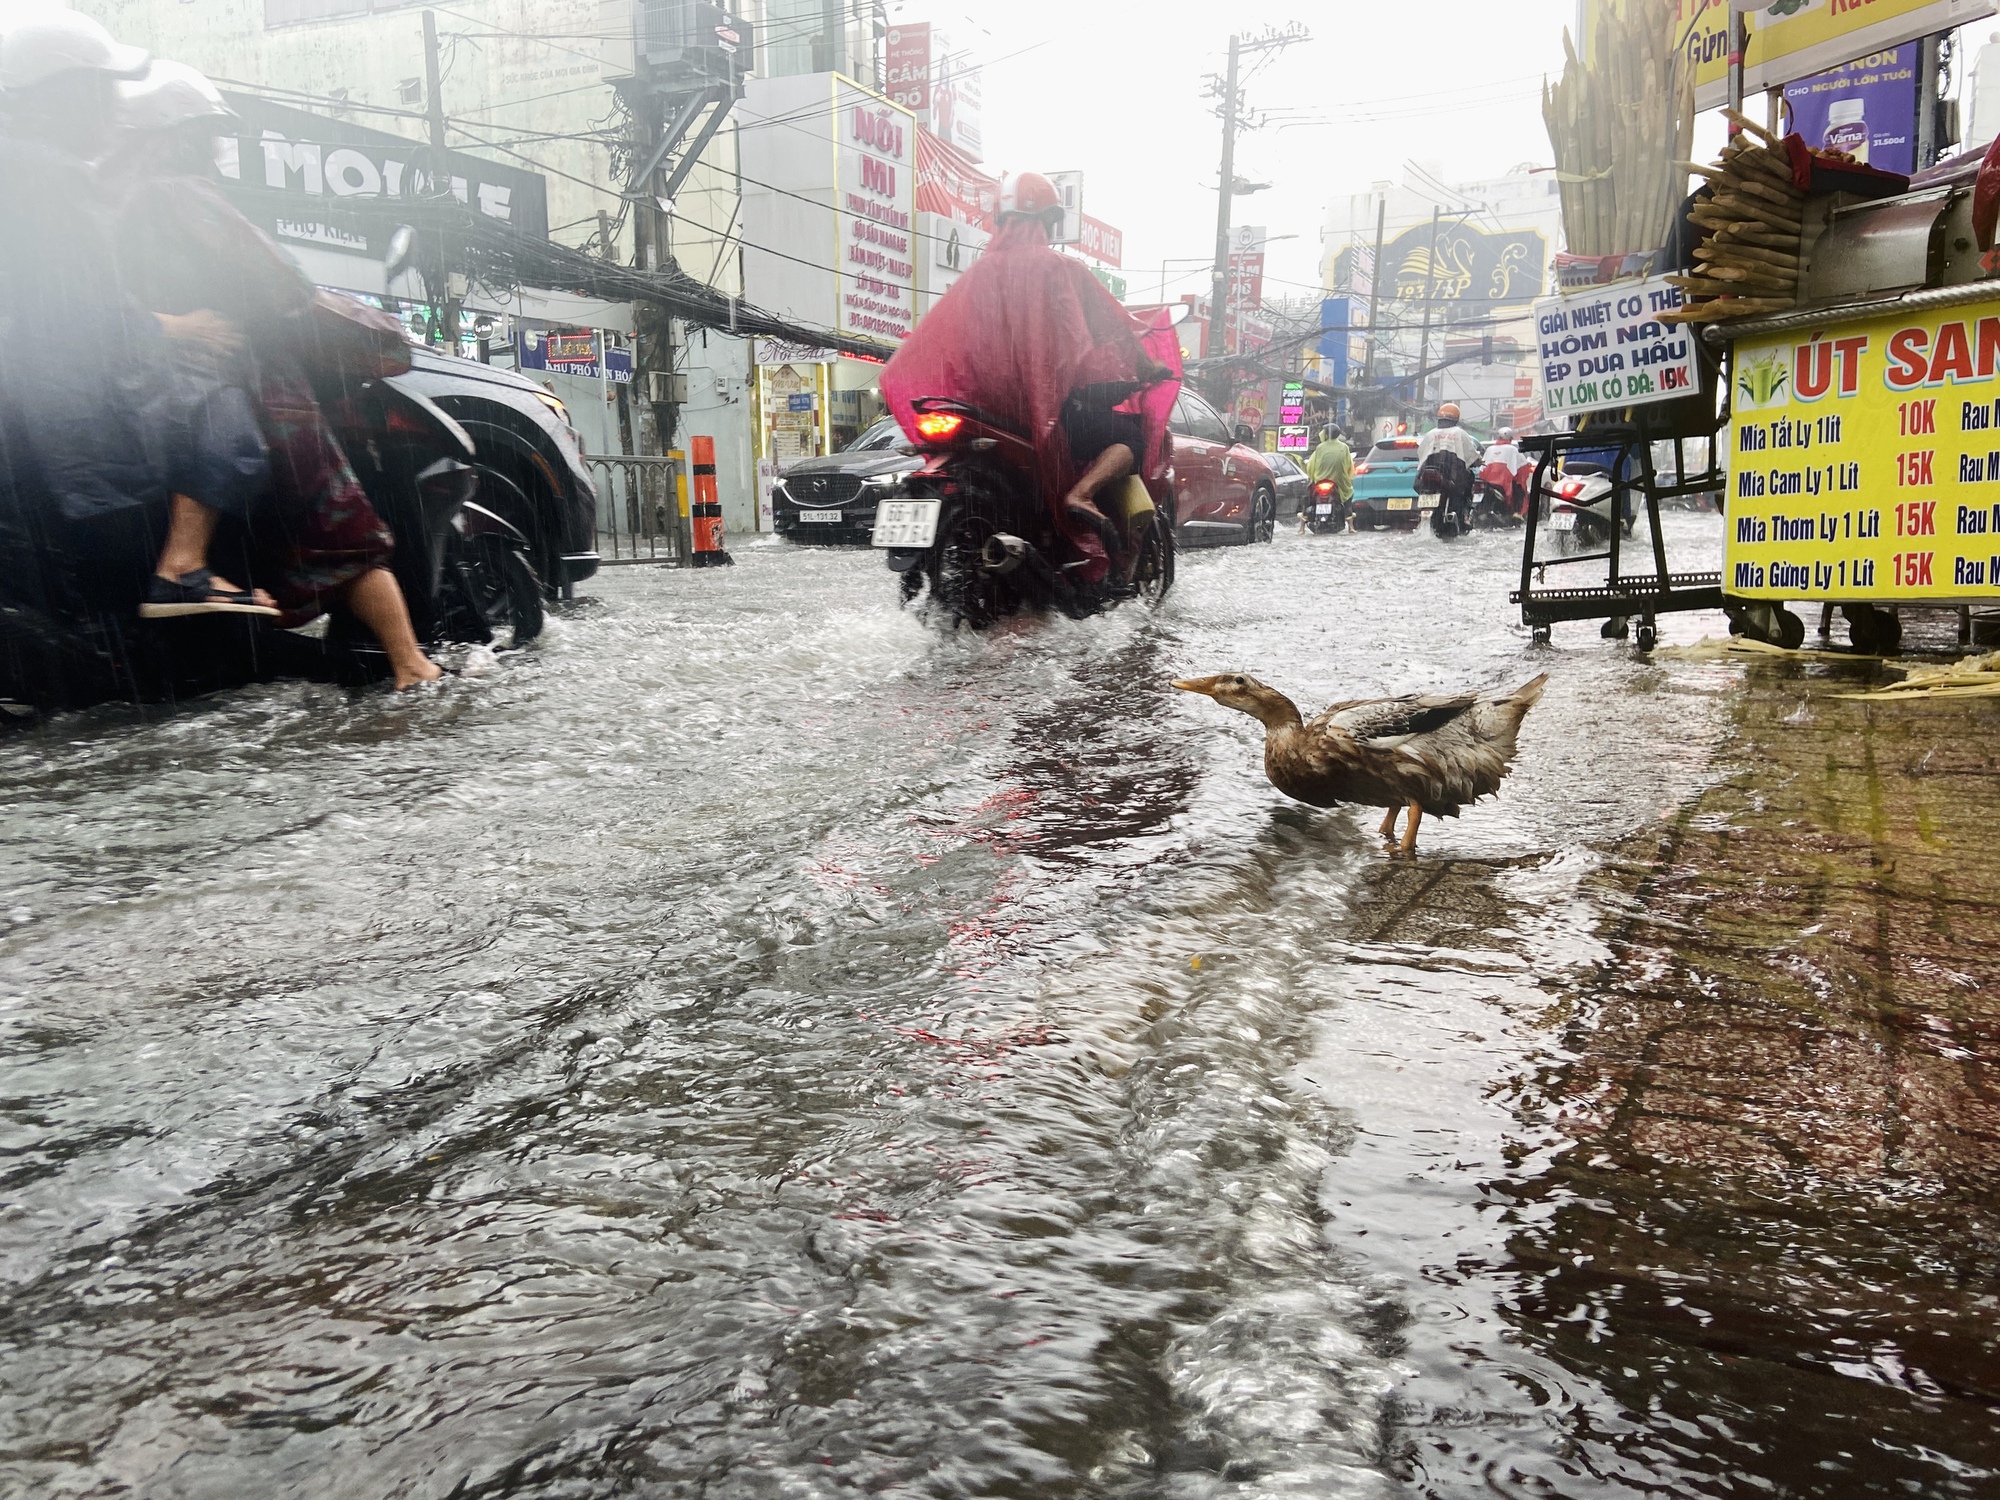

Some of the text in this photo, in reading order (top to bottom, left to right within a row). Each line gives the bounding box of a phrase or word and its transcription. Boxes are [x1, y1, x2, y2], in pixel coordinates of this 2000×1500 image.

[887, 60, 928, 84] CẦM
[1788, 67, 1911, 96] CHO NGƯỜI LỚN TUỔI
[894, 85, 922, 106] ĐỒ
[853, 106, 902, 158] NỐI
[860, 153, 895, 198] MI
[1081, 220, 1121, 260] HỌC VIÊN
[1540, 306, 1568, 335] GIẢI
[1572, 299, 1611, 328] NHIỆT
[1617, 295, 1642, 319] CƠ
[1542, 322, 1678, 359] HÔM NAY
[571, 361, 592, 377] PHỐ
[593, 366, 613, 380] VN
[1545, 361, 1571, 383] ÉP
[1632, 336, 1687, 368] HẤU
[1793, 331, 1870, 403] ÚT
[1548, 387, 1564, 409] LY
[1569, 379, 1598, 406] LỚN
[1602, 372, 1622, 400] CÓ
[1627, 369, 1654, 396] ĐÁ:
[1899, 399, 1937, 436] 10K
[1961, 401, 1989, 430] Rau
[1740, 423, 1766, 452] Mía
[1771, 416, 1792, 448] Tắt
[1796, 420, 1812, 449] Ly
[1738, 462, 1859, 498] Mía Cam Ly 1 Lít
[1897, 450, 1934, 487] 15K
[1959, 454, 1983, 483] Rau
[803, 512, 838, 521] 51L-131.32
[1737, 509, 1880, 542] Mía Thơm Ly 1 Lít
[1895, 501, 1937, 537] 15K
[1957, 505, 1987, 534] Rau
[1735, 558, 1874, 591] Mía Gừng Ly 1 Lít
[1893, 552, 1934, 586] 15K
[1955, 556, 1984, 586] Rau
